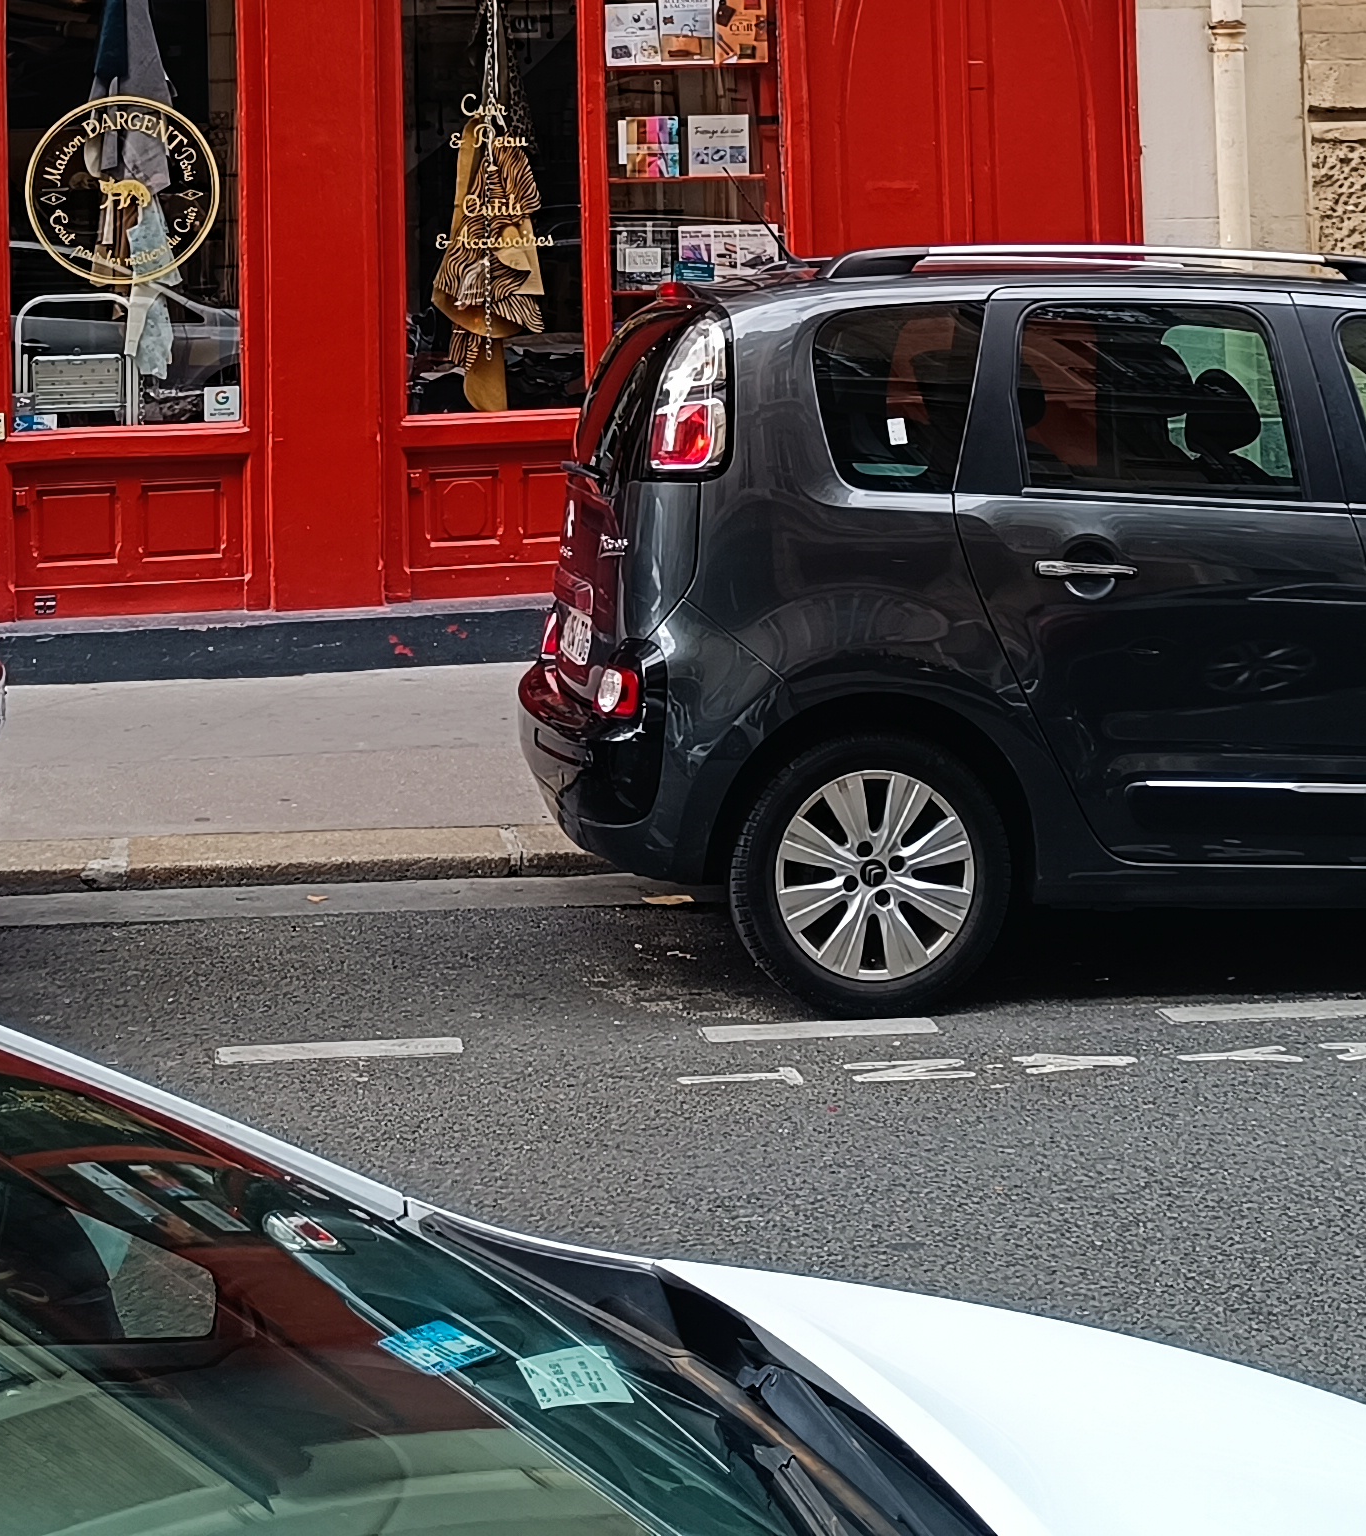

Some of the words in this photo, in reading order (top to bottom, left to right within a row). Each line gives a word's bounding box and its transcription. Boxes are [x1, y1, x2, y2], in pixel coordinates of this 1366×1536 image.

[460, 93, 508, 117] Cuir
[449, 132, 466, 149] &
[473, 123, 528, 148] Peau
[42, 135, 86, 187] Maison
[81, 111, 189, 151] DARGENT
[175, 147, 197, 182] Paris
[462, 194, 524, 217] Outils
[173, 206, 198, 232] Cuir
[167, 232, 182, 249] du
[435, 233, 453, 250] &
[455, 225, 556, 249] Accessoires
